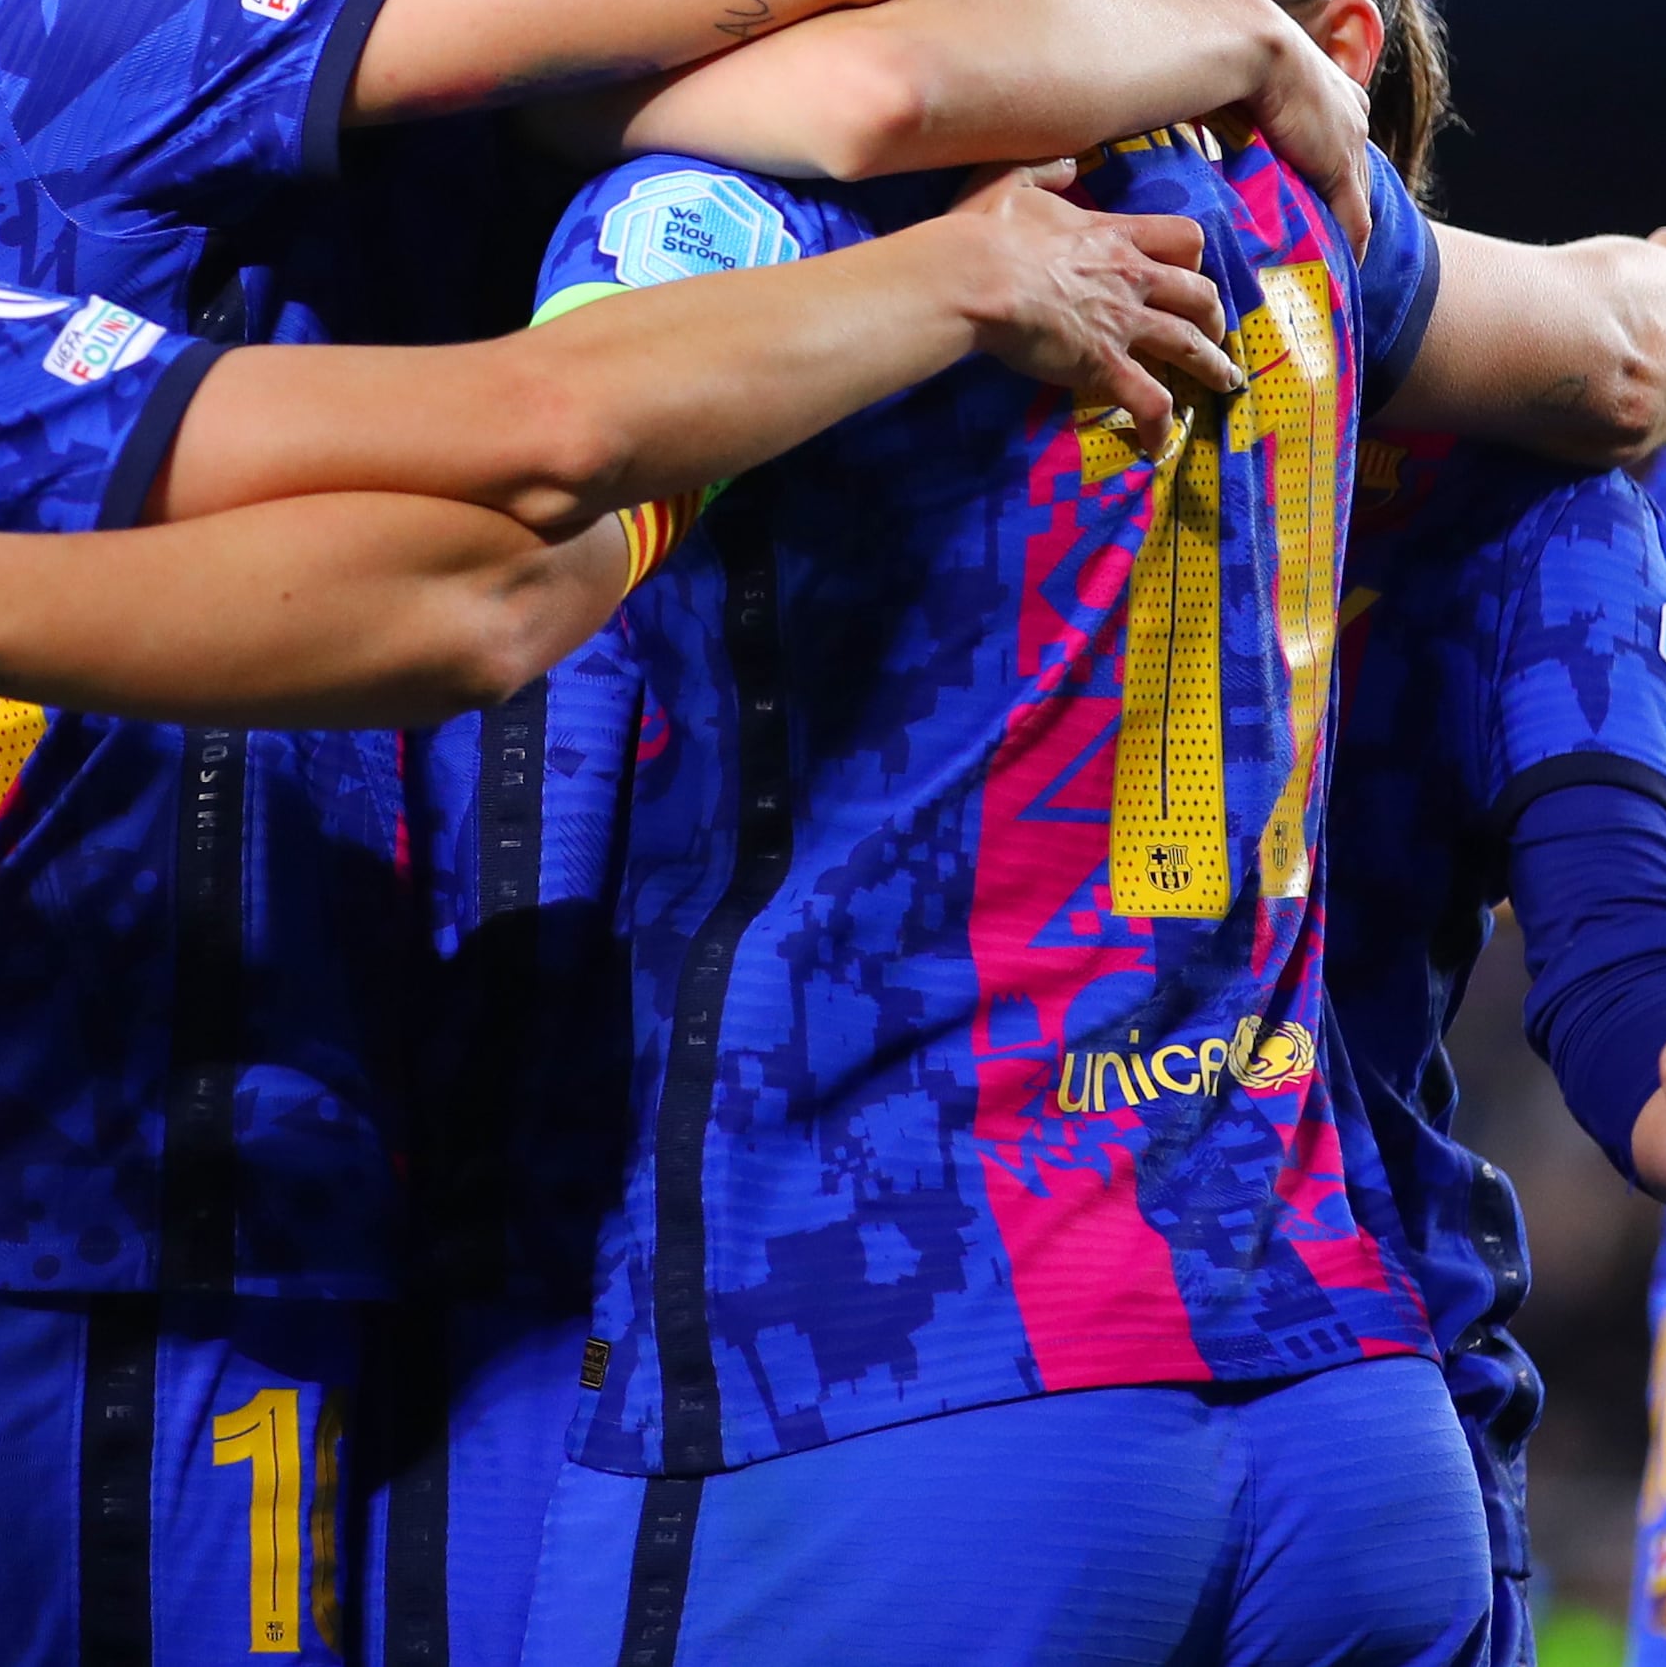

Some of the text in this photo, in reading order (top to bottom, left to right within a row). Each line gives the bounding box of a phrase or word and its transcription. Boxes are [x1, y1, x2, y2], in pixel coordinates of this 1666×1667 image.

[669, 206, 703, 223] We
[665, 221, 714, 248] Play
[663, 237, 737, 270] Strong
[52, 330, 85, 370] UEFA
